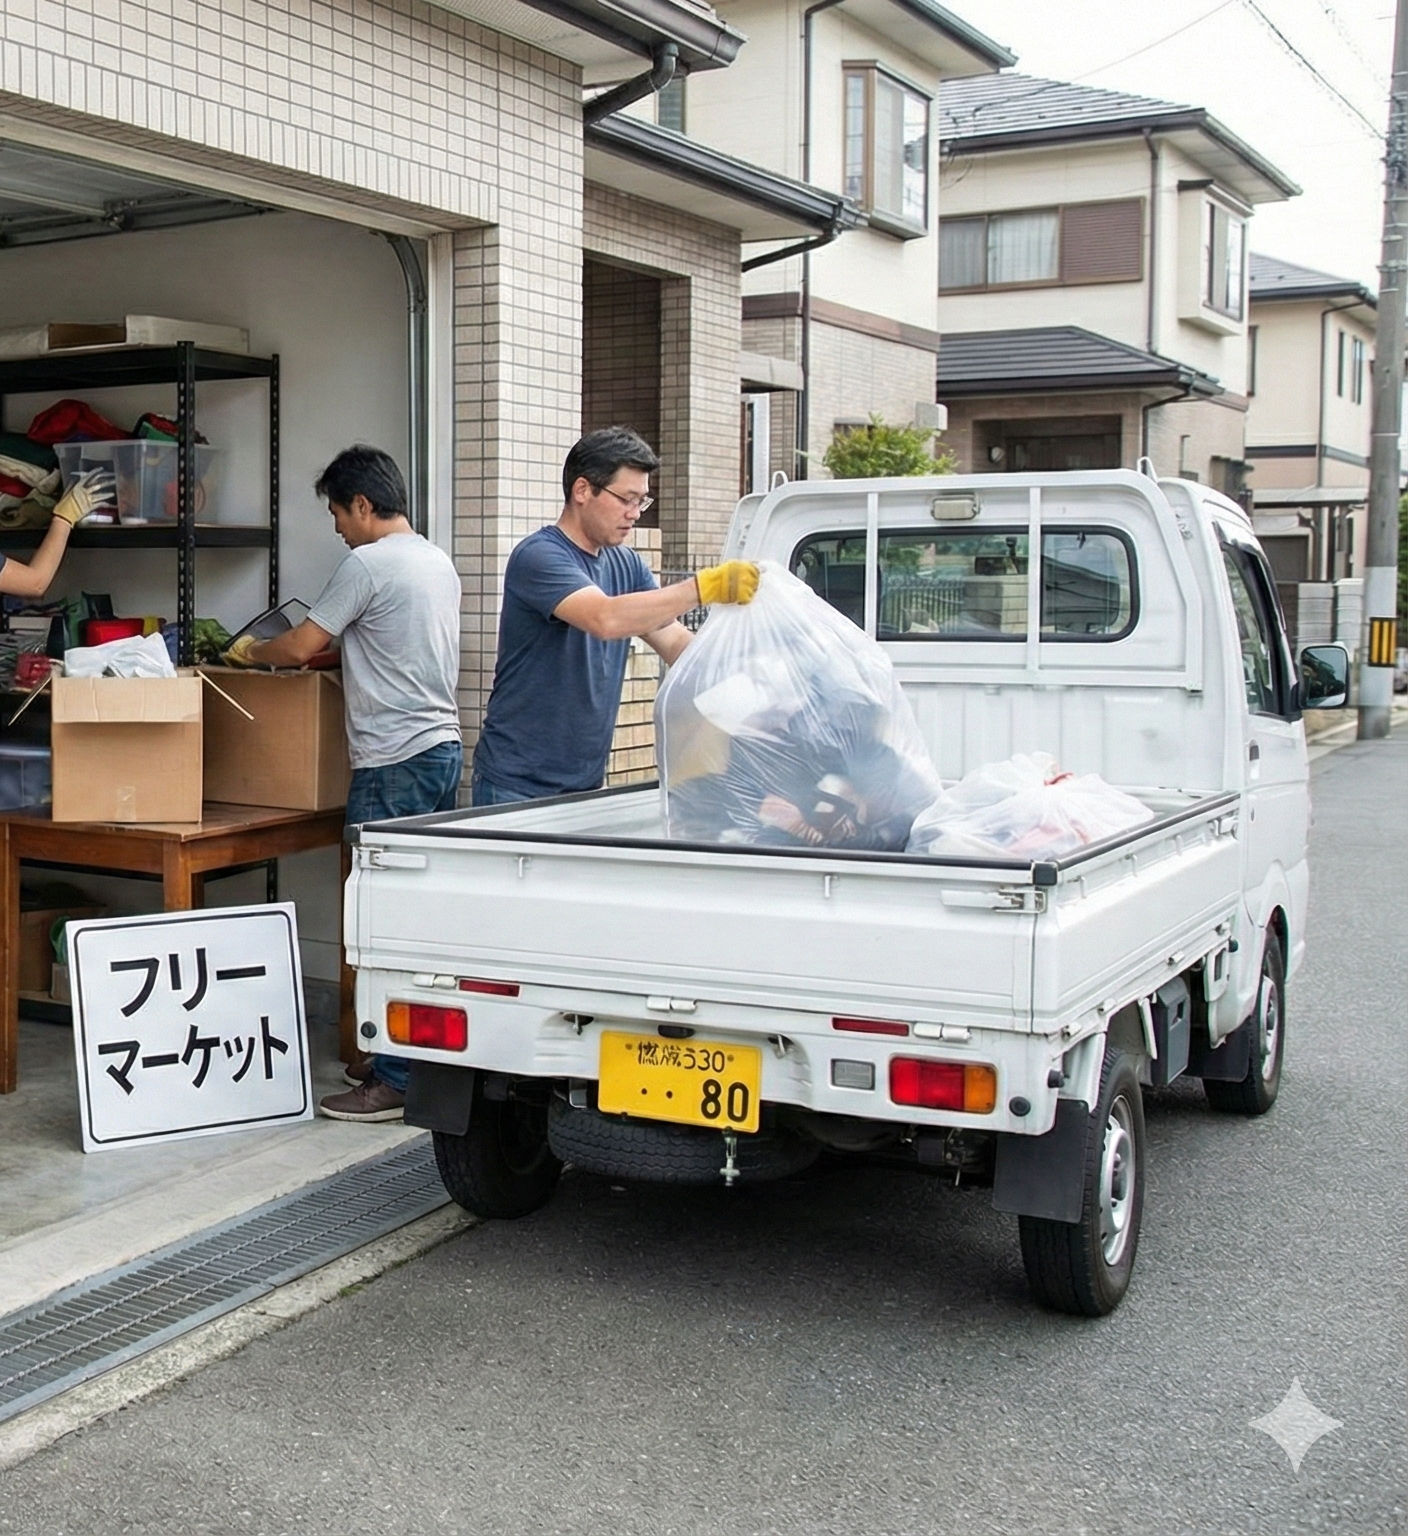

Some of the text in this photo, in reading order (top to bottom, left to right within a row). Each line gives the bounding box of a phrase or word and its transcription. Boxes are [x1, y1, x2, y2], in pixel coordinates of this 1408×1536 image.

[110, 947, 266, 1018] フリー
[98, 1016, 289, 1095] マーケット
